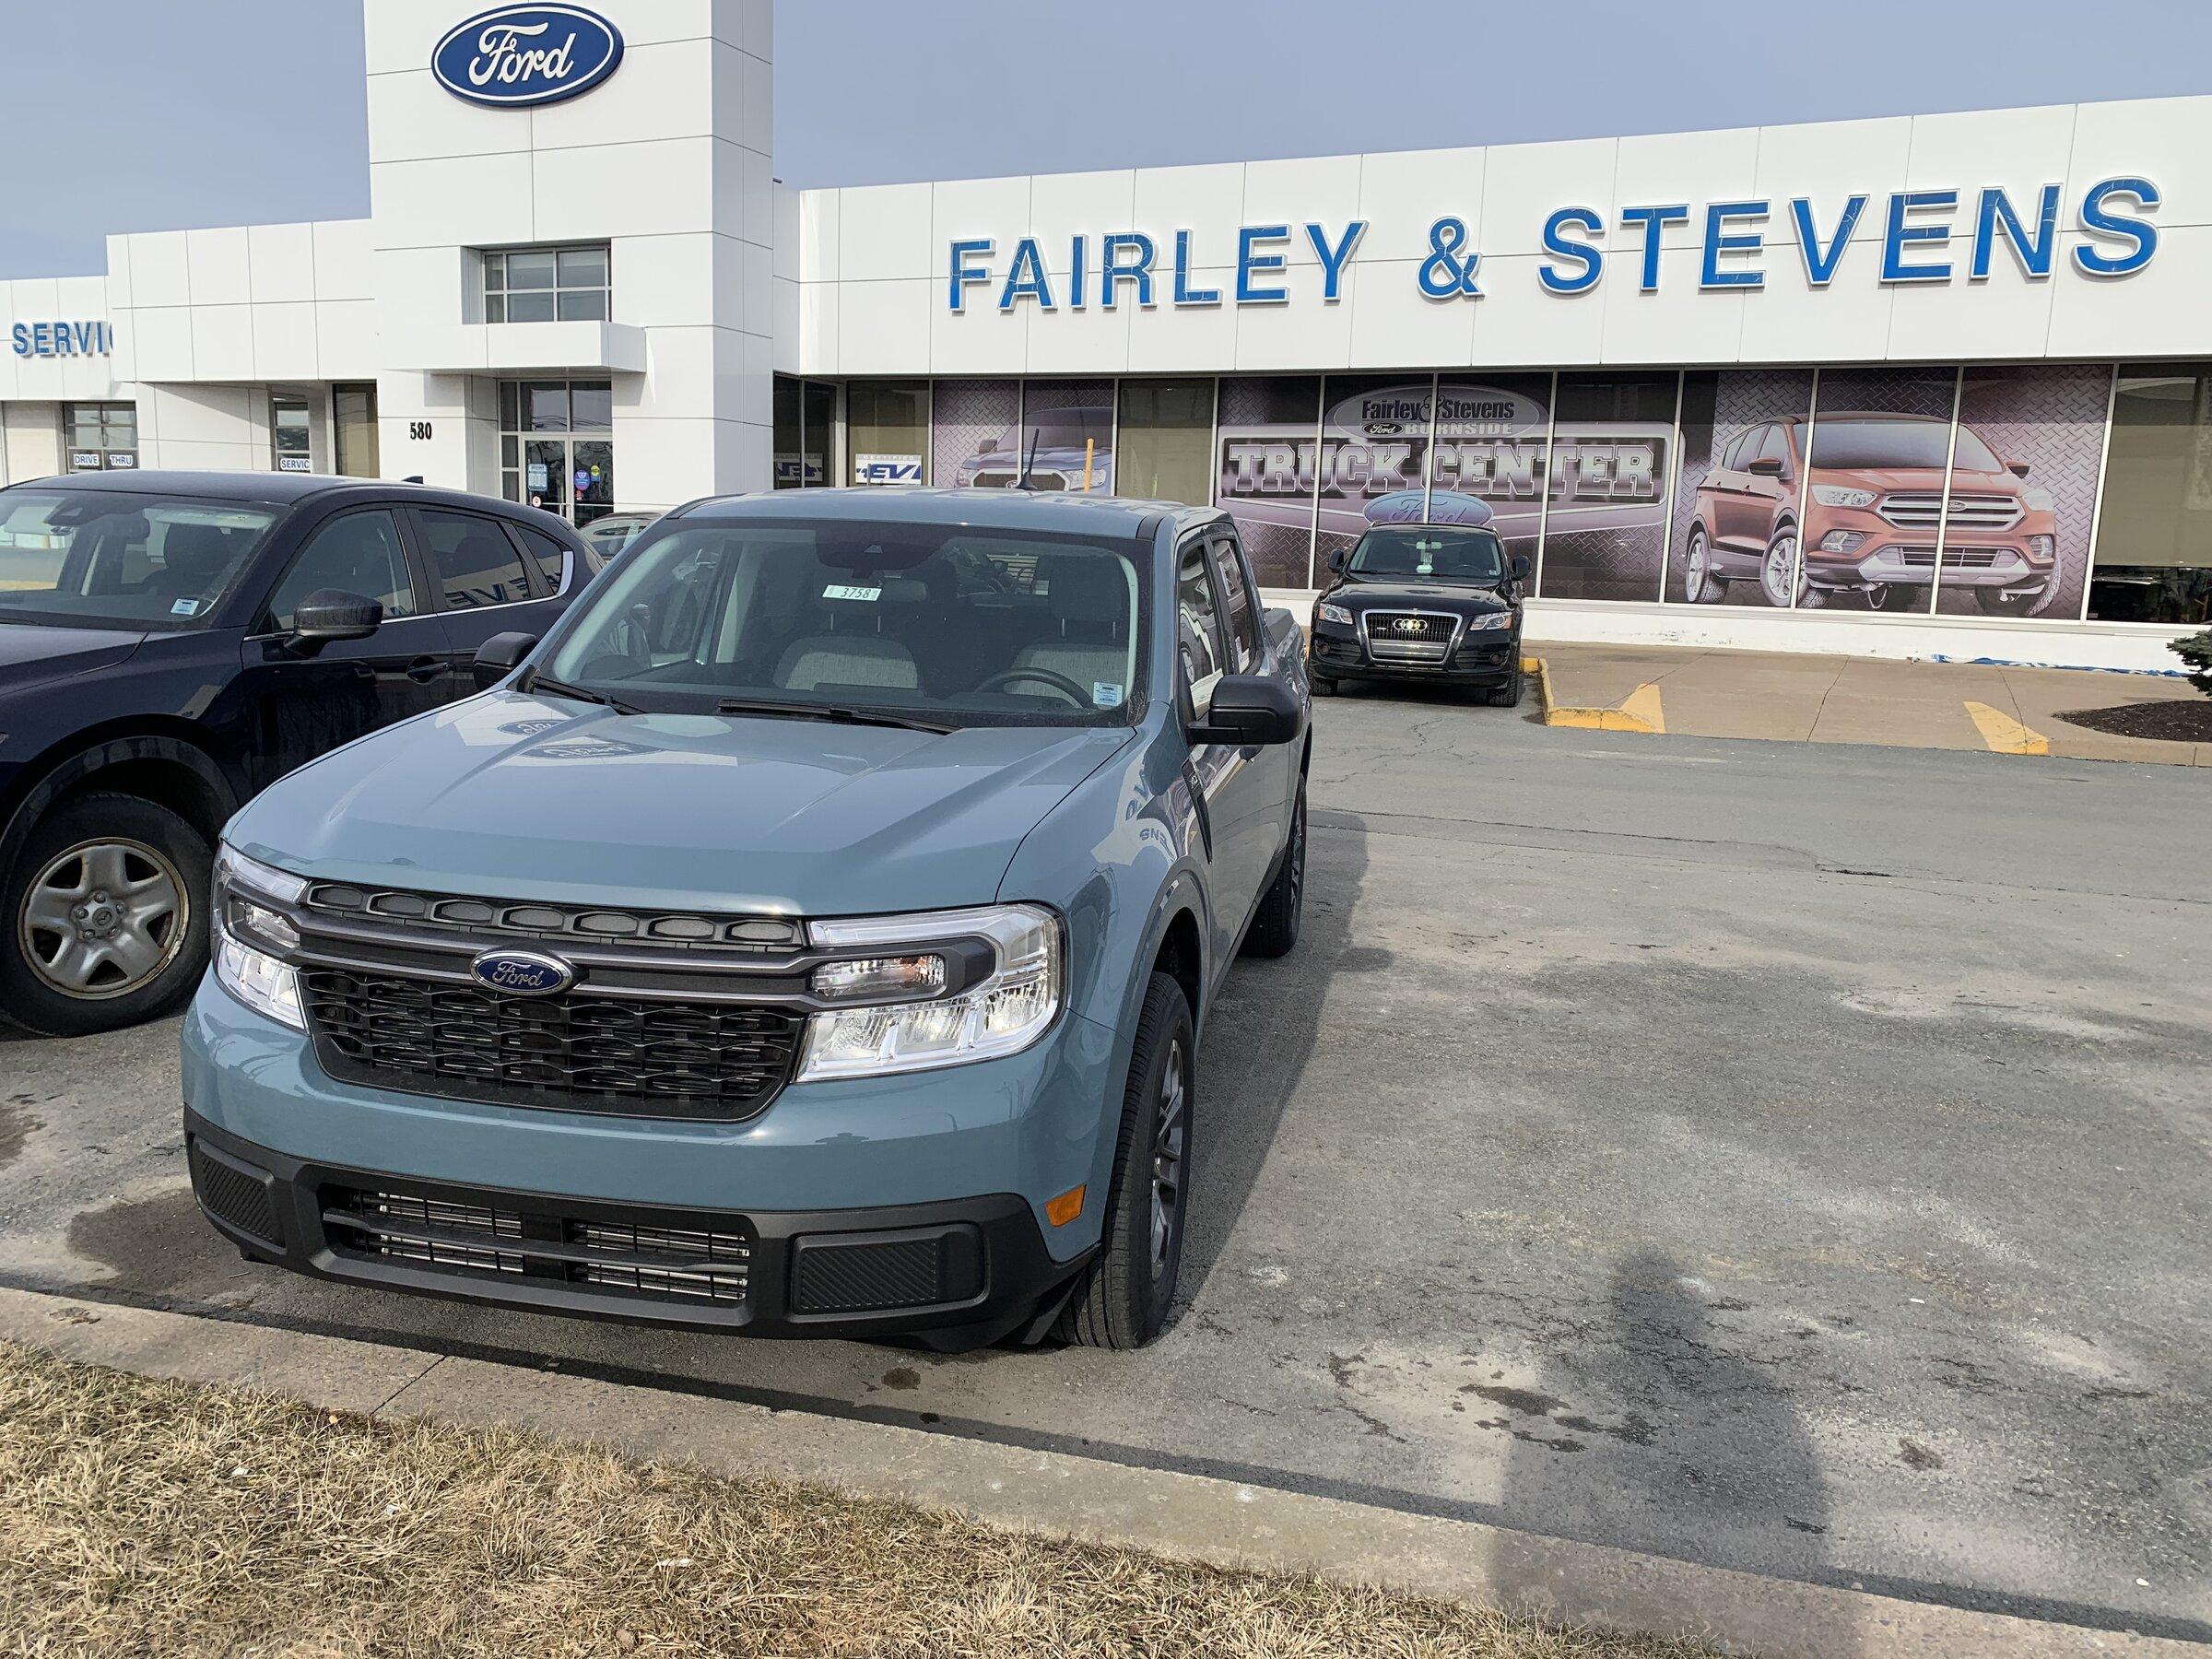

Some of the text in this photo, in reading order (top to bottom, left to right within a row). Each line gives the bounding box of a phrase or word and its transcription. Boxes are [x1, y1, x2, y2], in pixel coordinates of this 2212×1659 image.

[468, 22, 577, 86] Ford
[949, 175, 2162, 312] FAIRLEY & STEVENS
[1362, 399, 1421, 420] Fairley
[1441, 398, 1515, 420] Stevens
[410, 421, 432, 441] 580
[1406, 423, 1512, 435] BURNSIDE
[74, 455, 133, 465] DRIVE THRU
[1230, 444, 1655, 496] TRUCK CENTER
[841, 587, 872, 599] 3758
[491, 961, 544, 986] Ford
